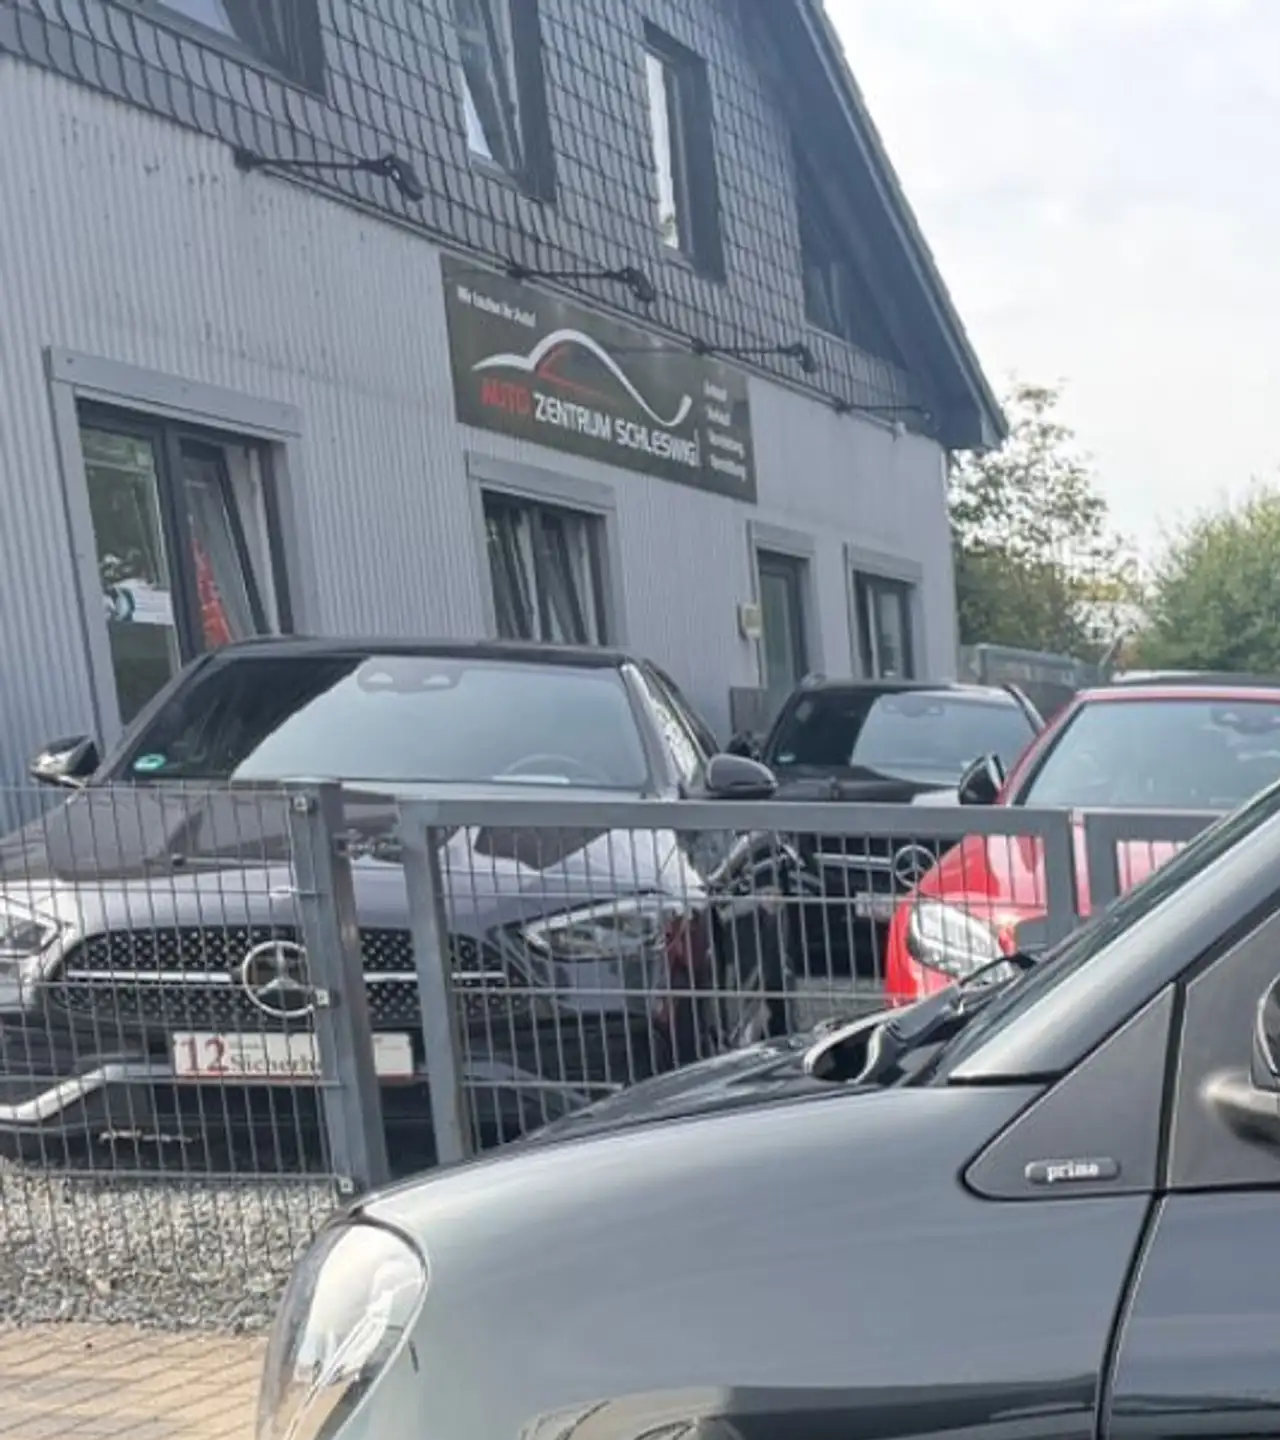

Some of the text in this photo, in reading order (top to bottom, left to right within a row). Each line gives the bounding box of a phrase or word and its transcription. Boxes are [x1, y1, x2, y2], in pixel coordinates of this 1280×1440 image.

[533, 391, 613, 442] ZENTRUM
[614, 419, 697, 467] SCHLESWIG
[180, 1036, 229, 1072] 12
[1047, 1161, 1099, 1182] prime
